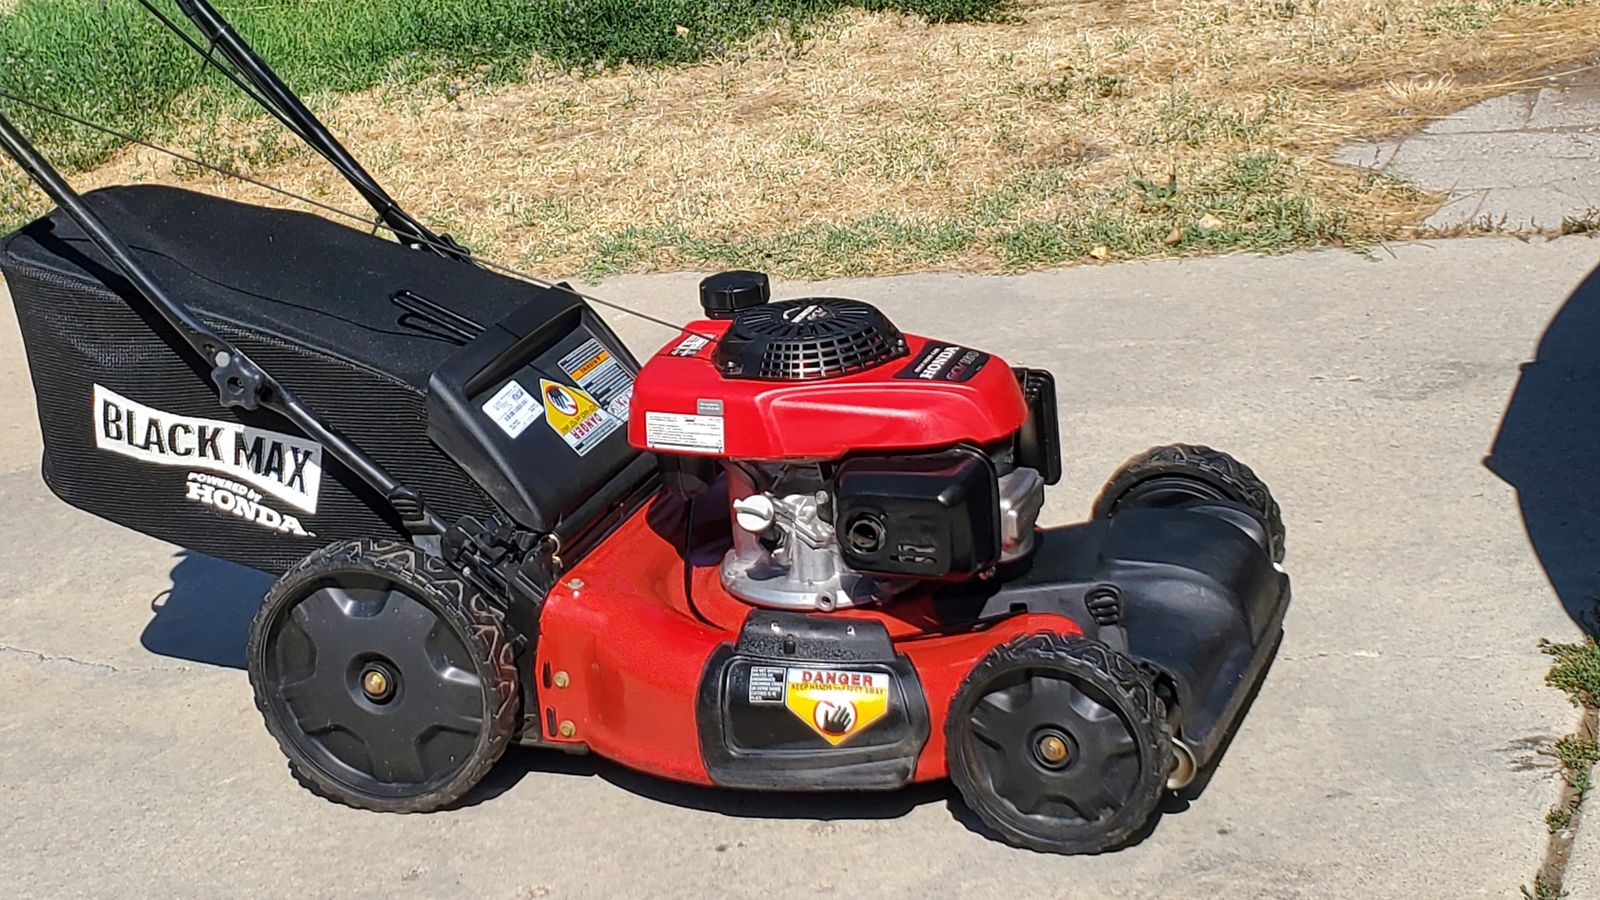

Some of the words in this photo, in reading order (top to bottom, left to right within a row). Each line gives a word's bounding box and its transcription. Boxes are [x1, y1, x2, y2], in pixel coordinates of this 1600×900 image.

[919, 346, 960, 380] HONDA
[570, 413, 603, 440] DANGER
[103, 398, 225, 464] BLACK
[235, 430, 313, 496] MAX
[187, 471, 248, 496] POWERED
[186, 481, 309, 536] HONDA
[791, 683, 808, 691] KEEP
[809, 683, 832, 691] HANDS
[802, 670, 873, 687] DANGER
